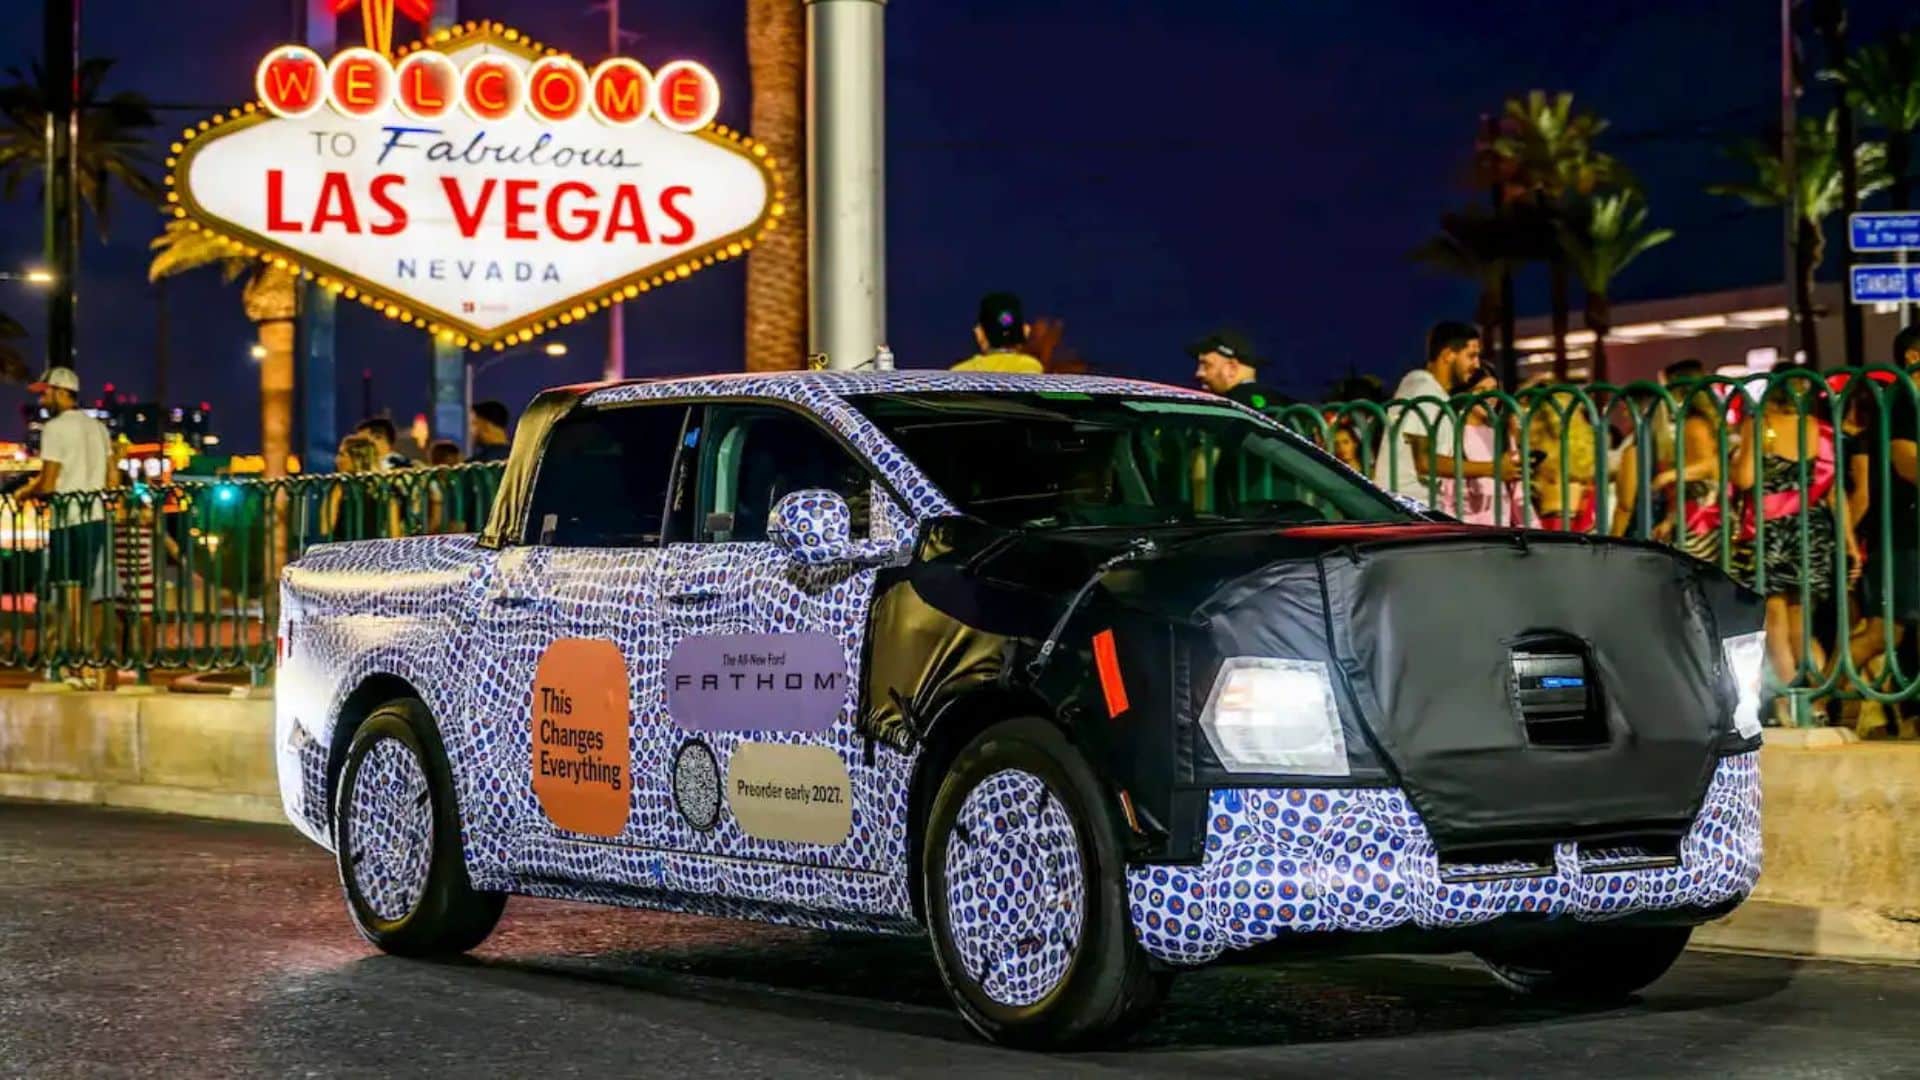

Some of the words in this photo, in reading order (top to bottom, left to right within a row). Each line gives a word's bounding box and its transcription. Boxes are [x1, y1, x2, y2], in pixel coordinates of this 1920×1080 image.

[271, 63, 699, 118] WELCOME
[308, 131, 356, 158] TO
[377, 126, 642, 169] Fabulous
[265, 169, 408, 235] LAS
[439, 177, 695, 246] VEGAS
[398, 257, 561, 284] NEVADA
[767, 651, 786, 666] Ford
[541, 687, 572, 715] This
[541, 718, 603, 754] Changes
[541, 750, 621, 790] Everything
[737, 780, 782, 799] Preorder
[785, 783, 810, 805] early
[812, 785, 844, 803] 2027.
